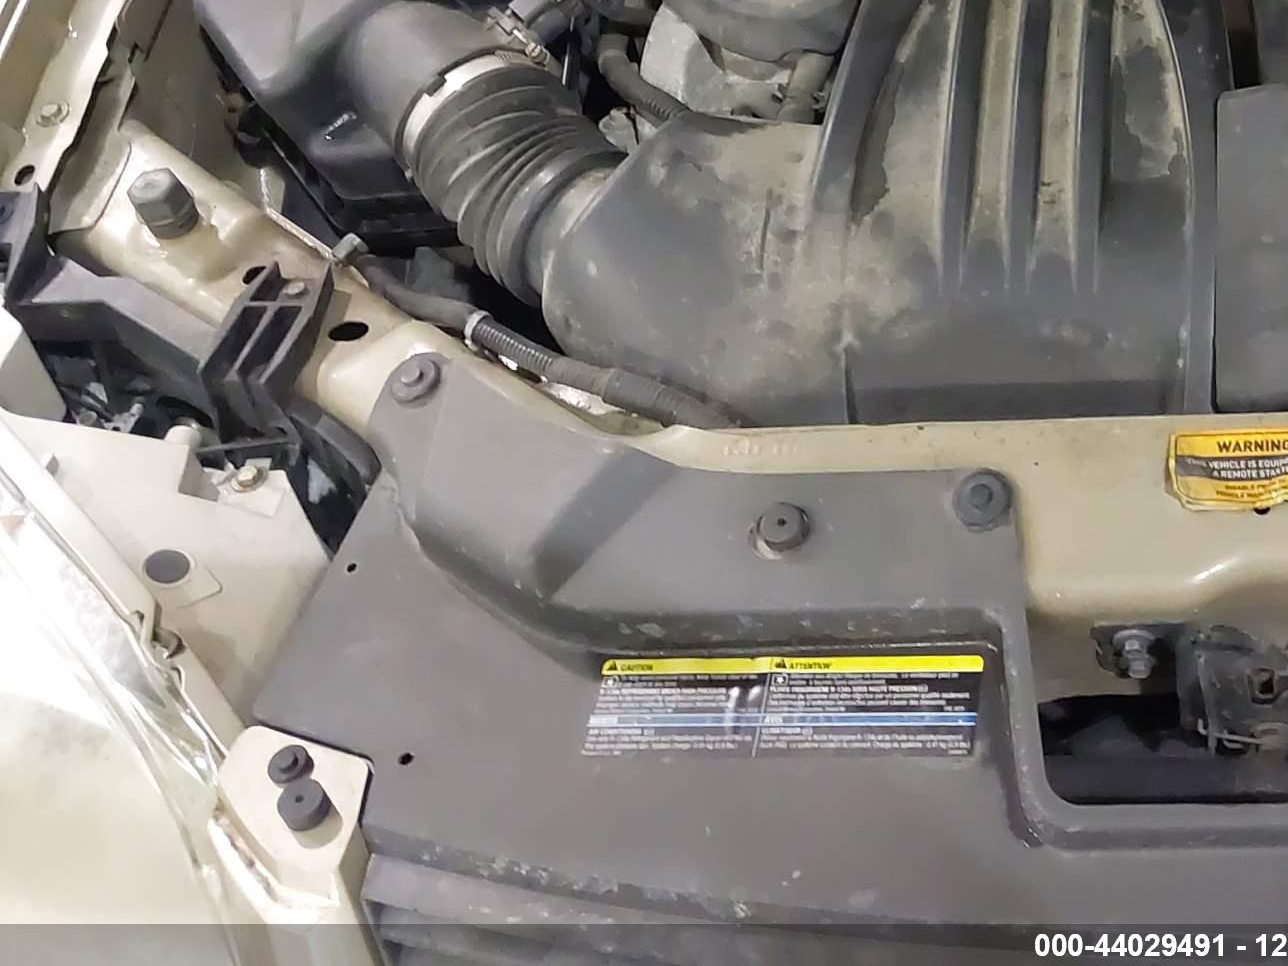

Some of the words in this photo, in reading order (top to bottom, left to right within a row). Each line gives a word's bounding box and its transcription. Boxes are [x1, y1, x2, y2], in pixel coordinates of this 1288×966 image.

[1208, 459, 1246, 470] VEHICLE
[1247, 459, 1257, 468] IS
[1211, 469, 1220, 478] A
[1220, 470, 1259, 479] REMOTE
